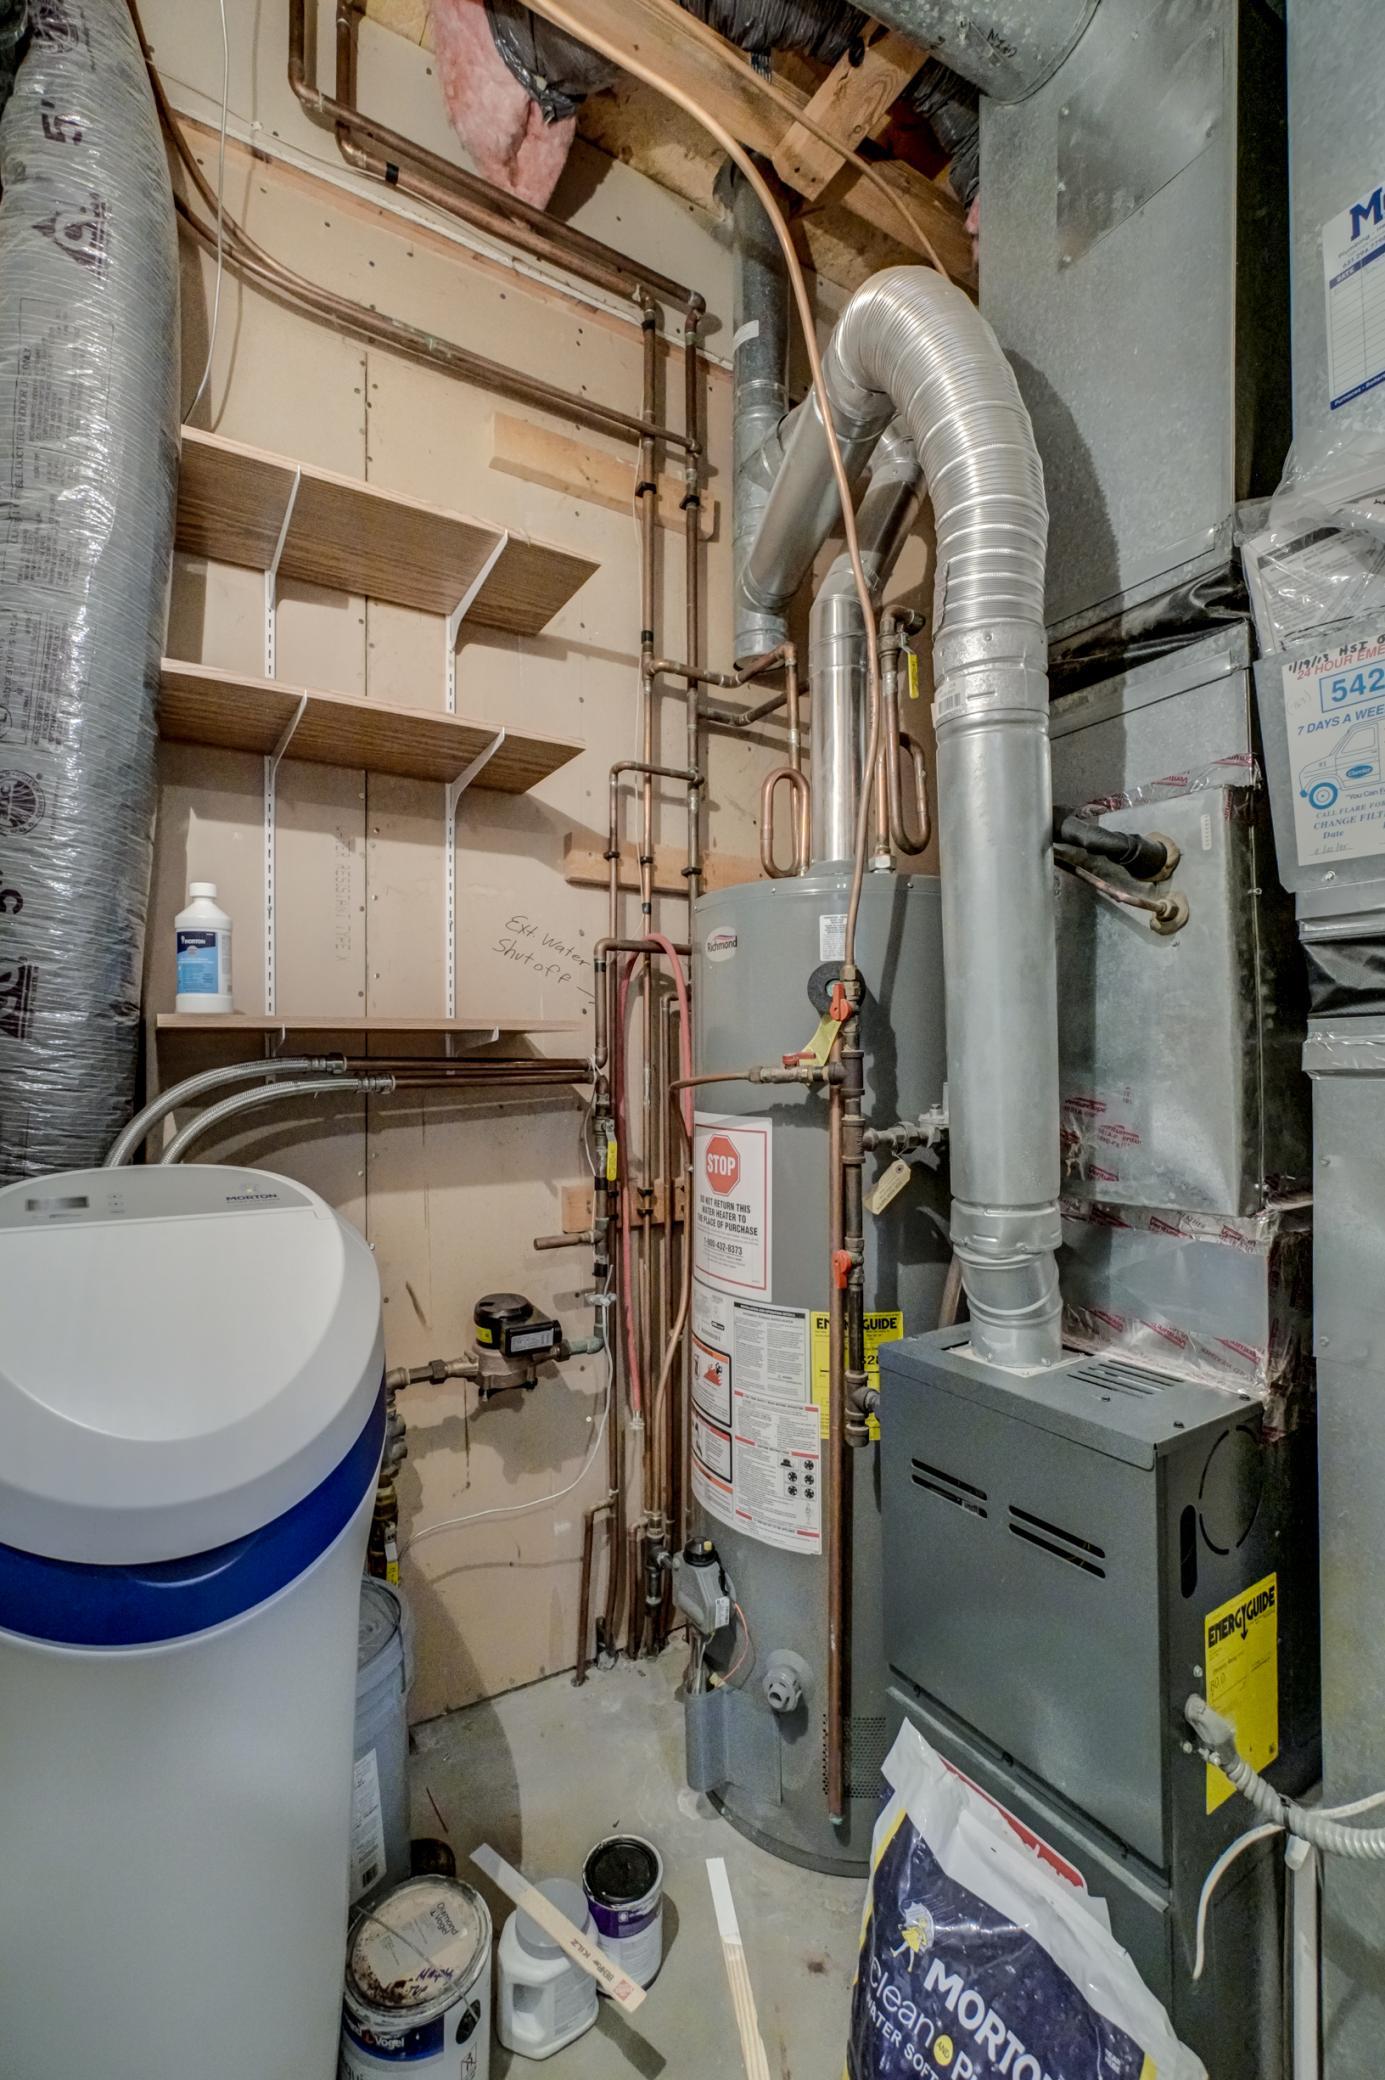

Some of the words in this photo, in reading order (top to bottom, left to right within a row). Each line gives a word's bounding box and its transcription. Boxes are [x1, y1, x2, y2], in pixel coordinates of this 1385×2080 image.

[1349, 187, 1385, 241] M
[1297, 668, 1311, 681] 24
[1315, 653, 1353, 675] HOUR
[1332, 667, 1385, 703] 542
[1297, 726, 1304, 736] 7
[1307, 715, 1340, 734] DAYS
[1342, 713, 1352, 724] A
[1313, 816, 1357, 830] CHANGE
[1360, 810, 1385, 822] FILT
[1323, 830, 1344, 839] Date
[542, 933, 590, 966] Water
[707, 937, 738, 953] Richmond
[707, 1153, 736, 1176] STOP
[702, 1206, 716, 1217] WATER
[716, 1210, 737, 1222] HEATER
[738, 1214, 747, 1224] TO
[714, 1199, 735, 1212] RETURN
[736, 1203, 751, 1214] THIS
[703, 1215, 716, 1228] PLACE
[717, 1219, 724, 1229] OF
[725, 1222, 758, 1237] PURCHASE
[570, 1938, 591, 1959] KILZ
[866, 1993, 902, 2048] WATER
[869, 1955, 935, 2047] Clean
[951, 2050, 978, 2080] P
[924, 1958, 1065, 2080] MORTO
[375, 2036, 405, 2051] Vogel
